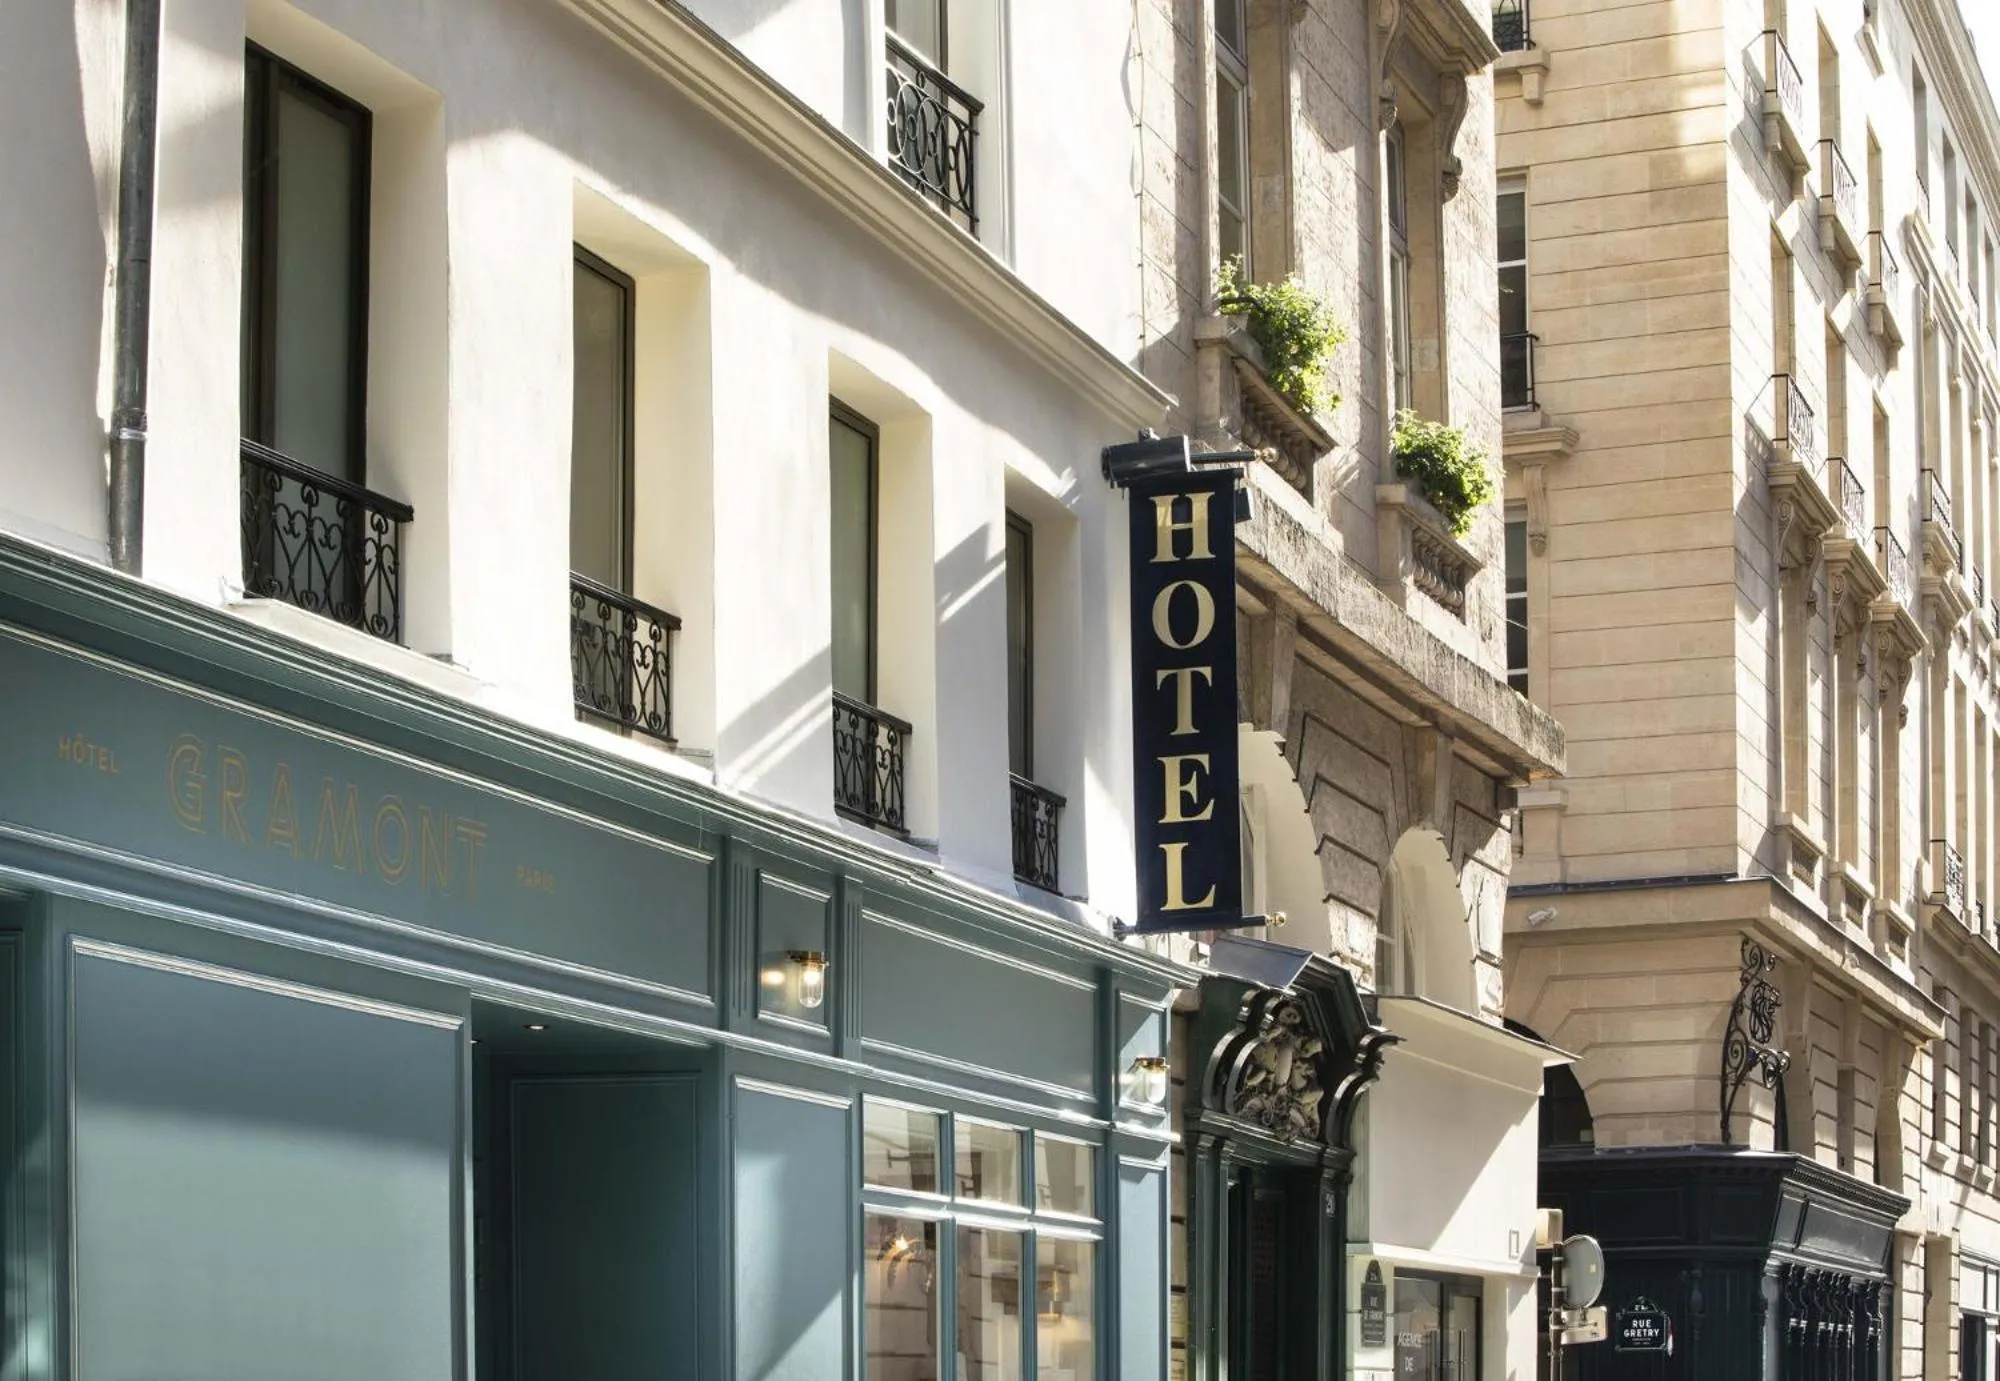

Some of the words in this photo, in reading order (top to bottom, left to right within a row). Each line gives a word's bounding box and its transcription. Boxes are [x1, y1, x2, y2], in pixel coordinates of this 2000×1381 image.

[1148, 491, 1216, 912] HOTEL
[58, 733, 120, 775] HÔTEL
[164, 732, 489, 902] GRAMONT
[1623, 1328, 1660, 1338] GRETRY
[1632, 1319, 1652, 1328] RUE
